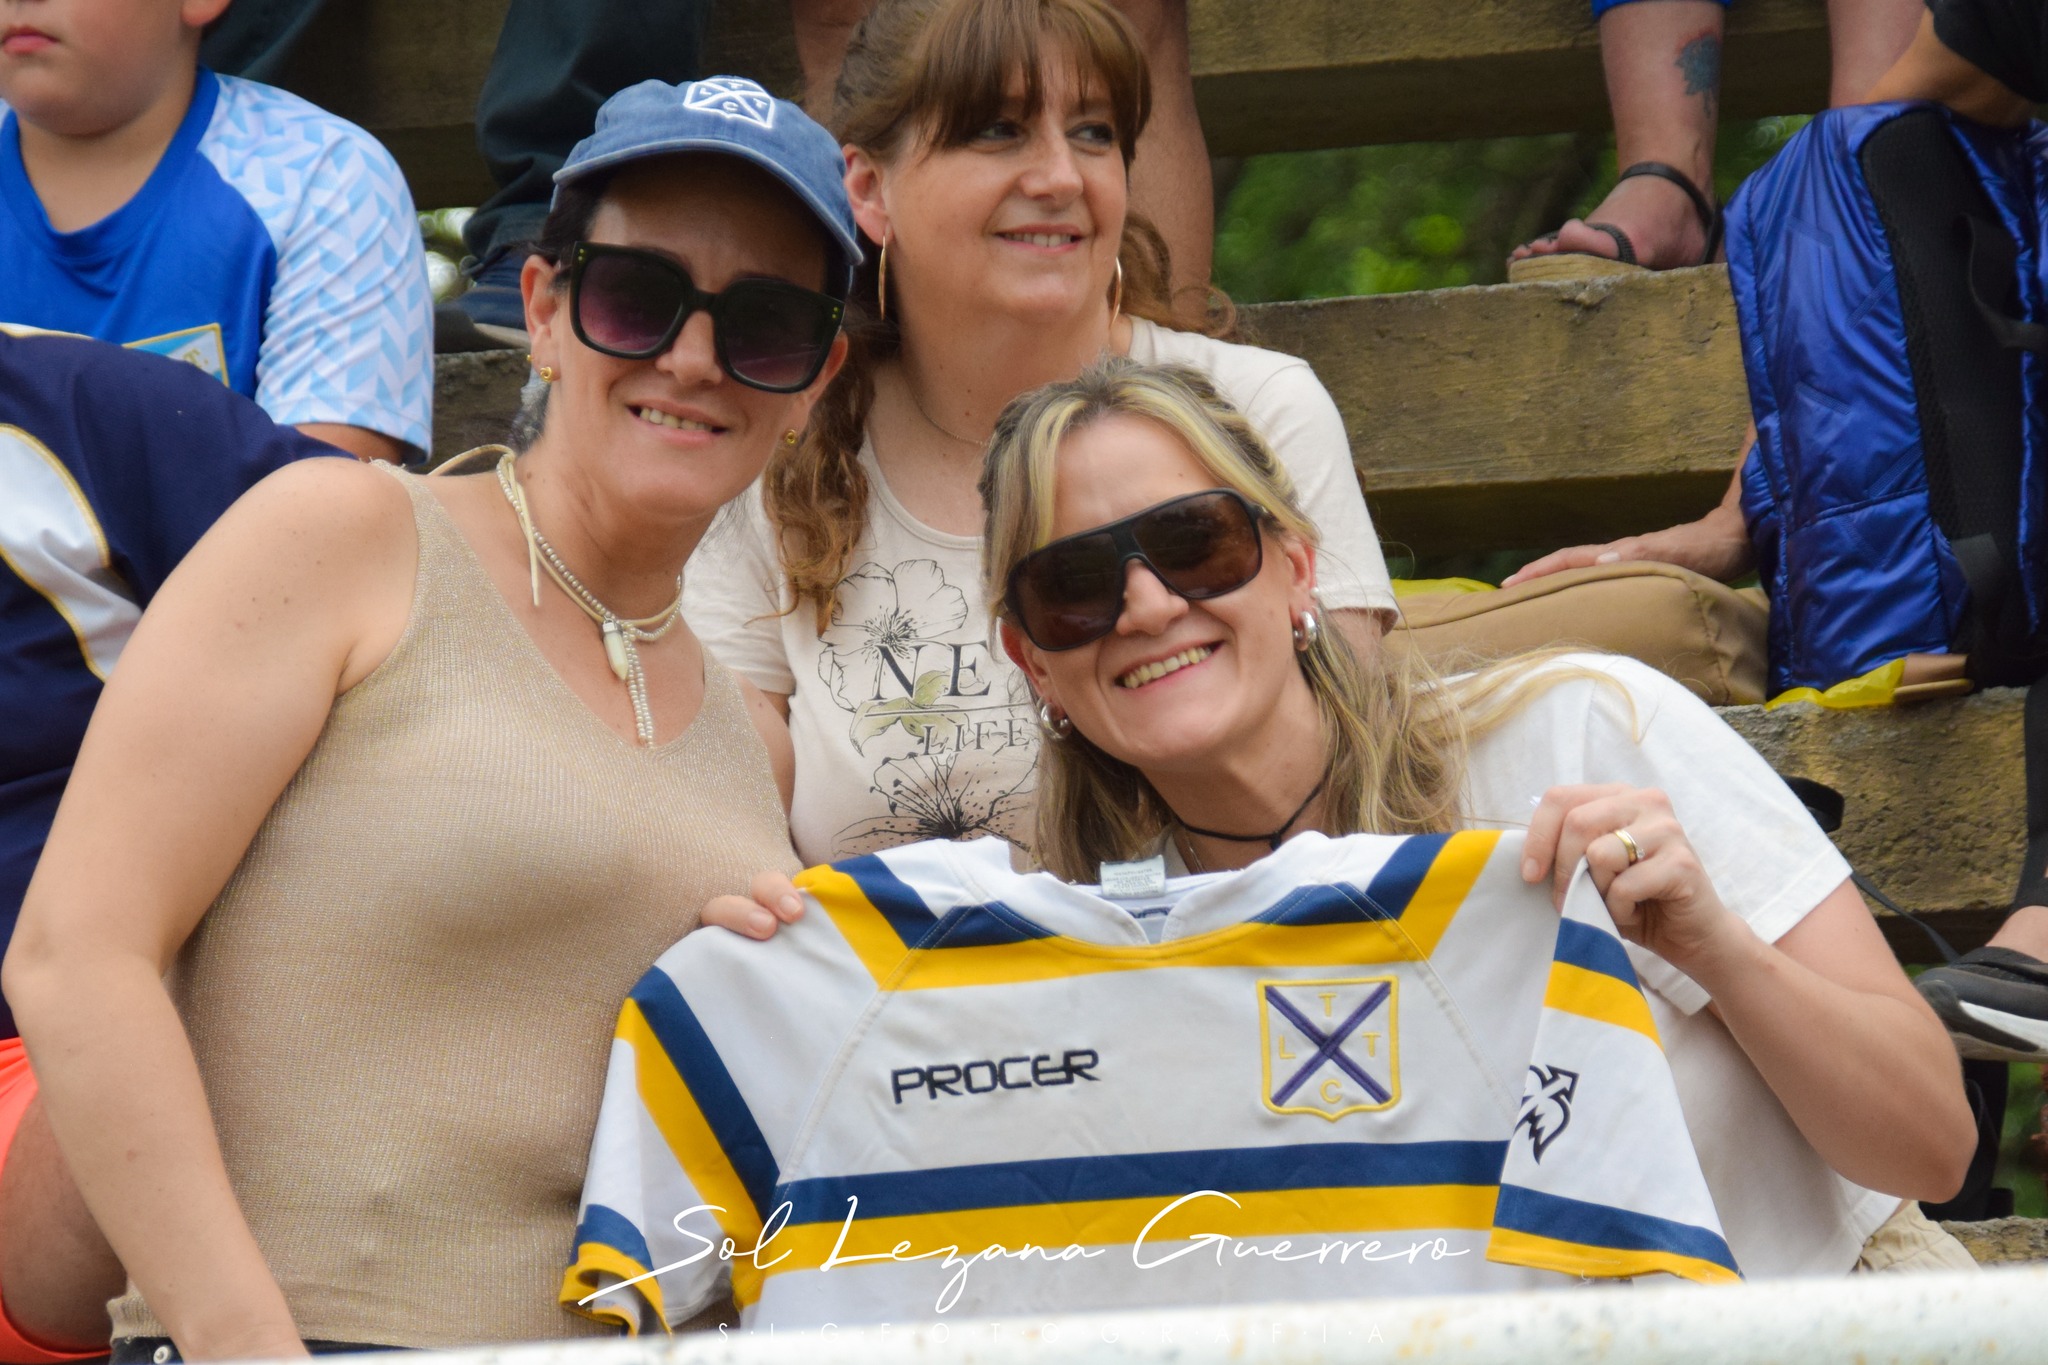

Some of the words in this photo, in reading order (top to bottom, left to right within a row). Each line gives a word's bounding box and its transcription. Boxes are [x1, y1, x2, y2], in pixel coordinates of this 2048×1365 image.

[870, 641, 991, 700] NE
[922, 717, 1029, 755] LIFE
[1318, 993, 1336, 1017] T
[1279, 1036, 1295, 1059] L
[1362, 1033, 1380, 1057] T
[891, 1048, 1102, 1104] PROCER
[1320, 1080, 1341, 1103] C
